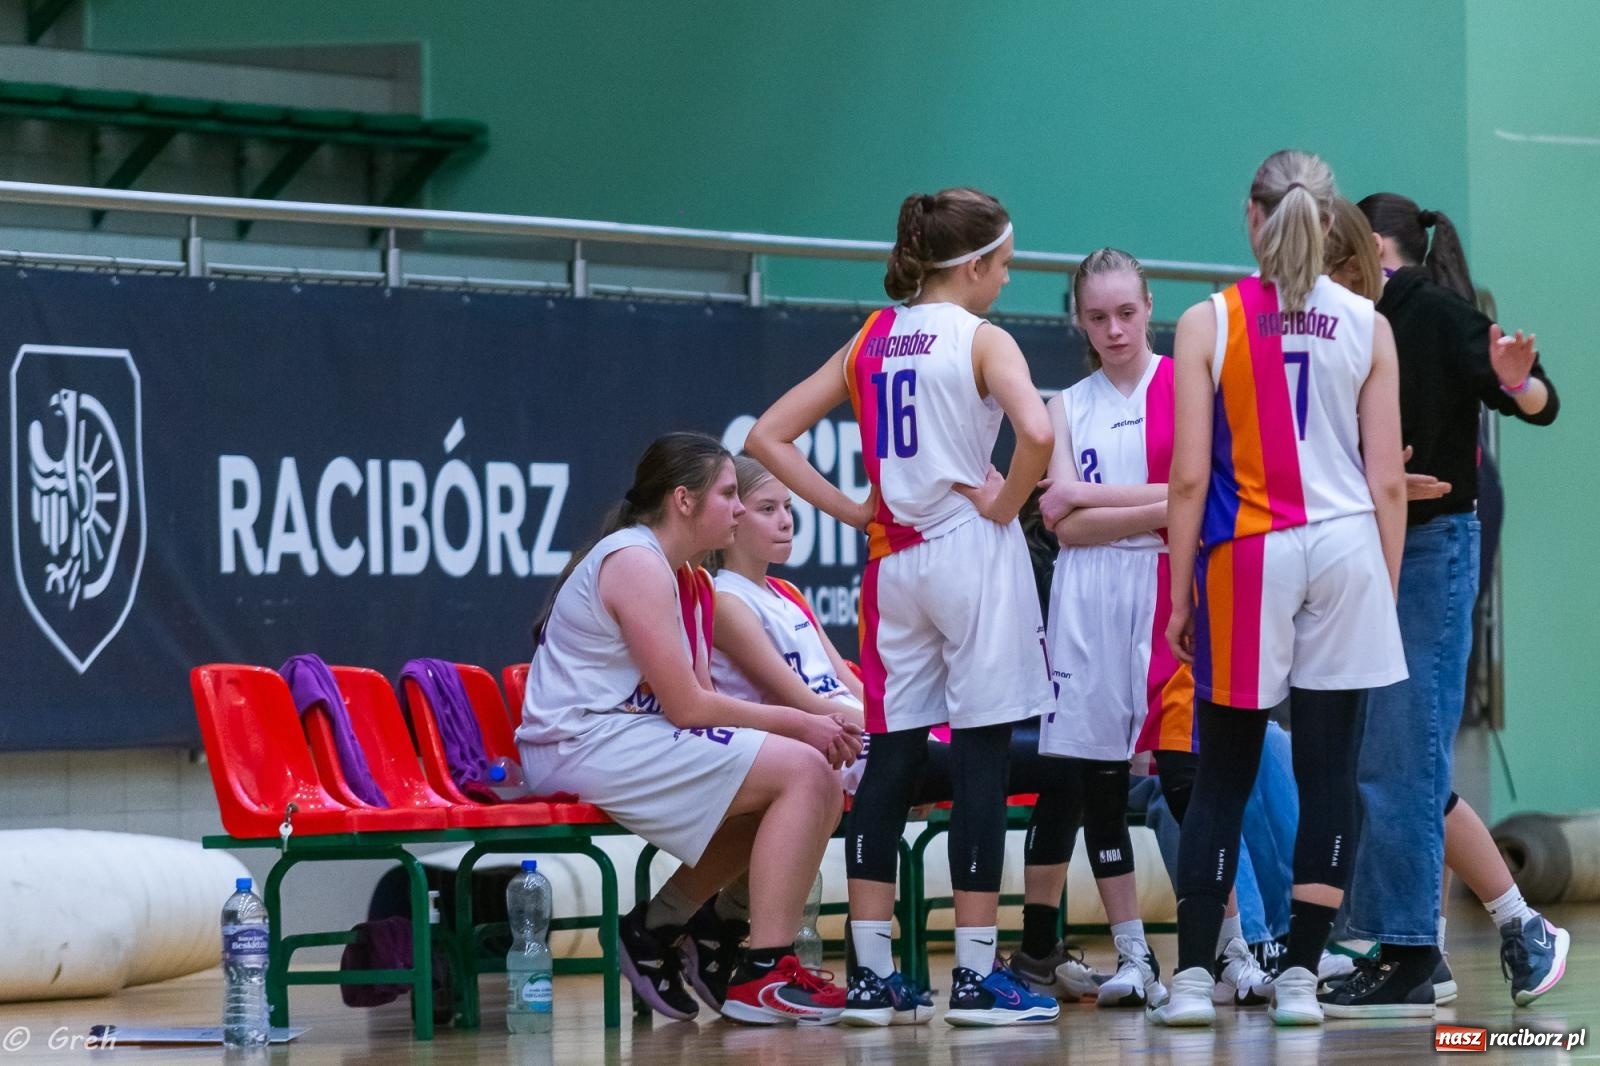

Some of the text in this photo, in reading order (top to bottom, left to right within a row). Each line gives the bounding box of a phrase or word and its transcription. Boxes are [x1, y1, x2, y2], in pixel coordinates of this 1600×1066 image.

[871, 368, 918, 459] 16
[1283, 351, 1310, 441] 7
[218, 416, 571, 577] RACIBÓRZ
[1106, 848, 1122, 862] NBA
